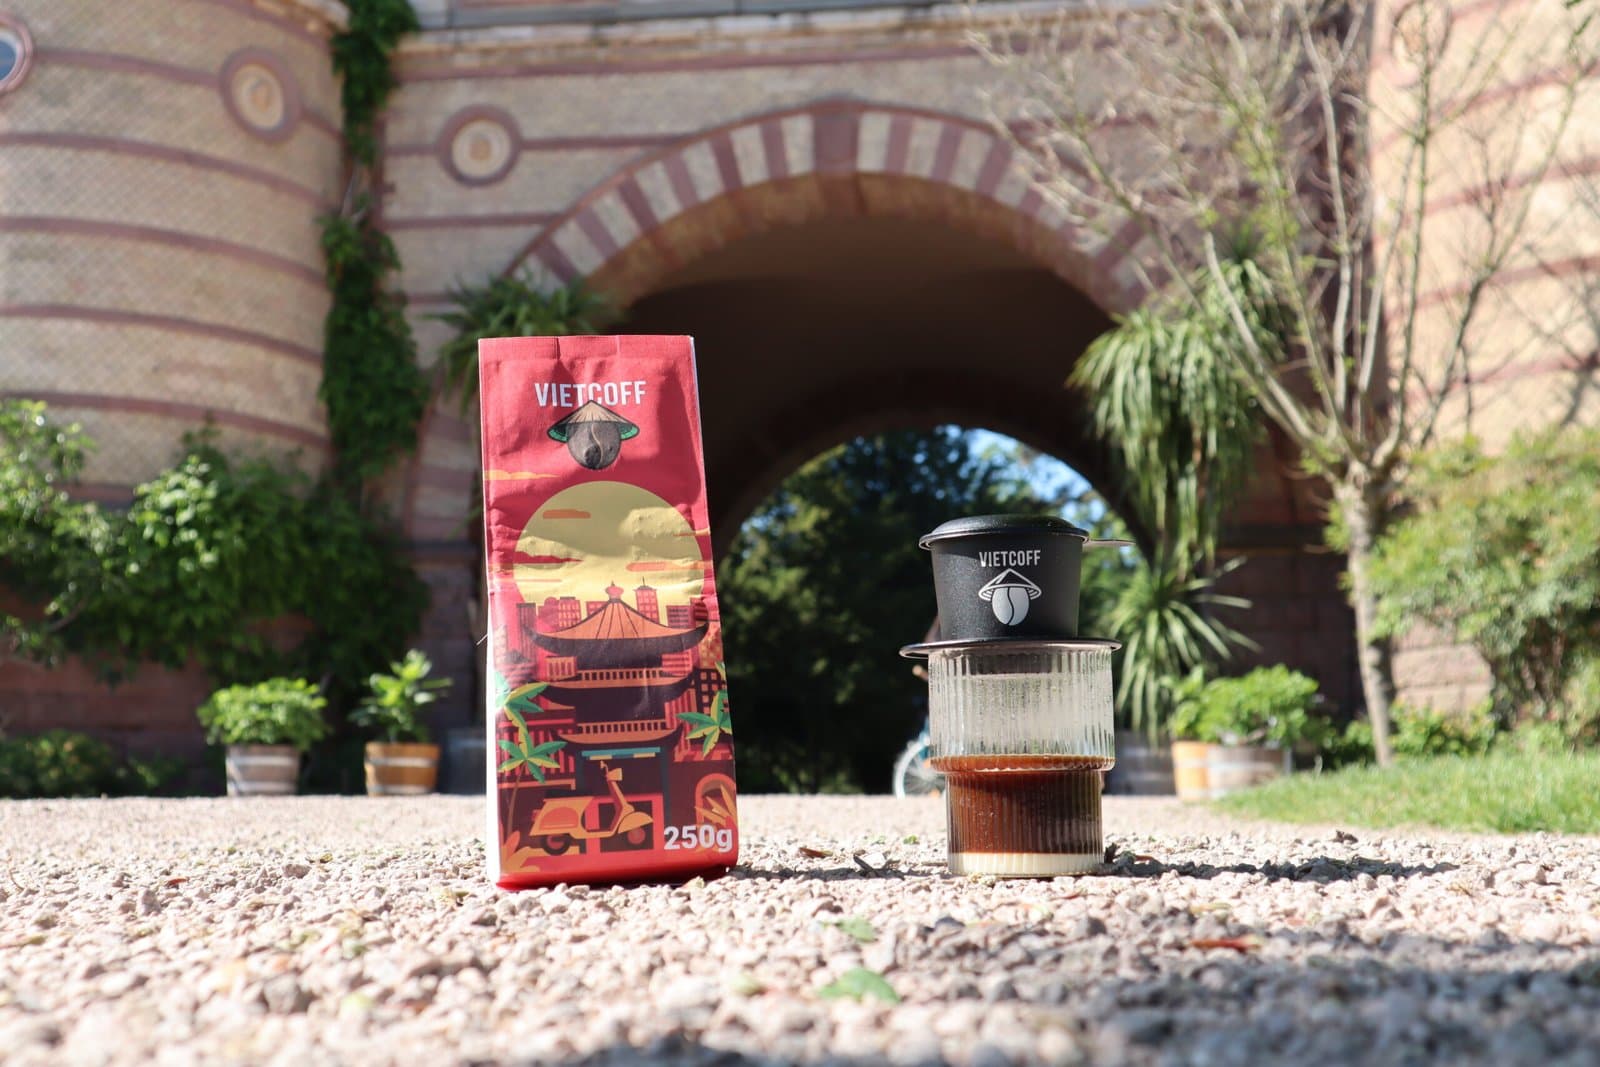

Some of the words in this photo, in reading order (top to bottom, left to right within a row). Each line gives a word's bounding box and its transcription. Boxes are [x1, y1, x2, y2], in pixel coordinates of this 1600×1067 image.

[534, 381, 647, 408] VIETCOFF
[979, 550, 1041, 568] VIETCOFF
[663, 824, 733, 853] 250g
